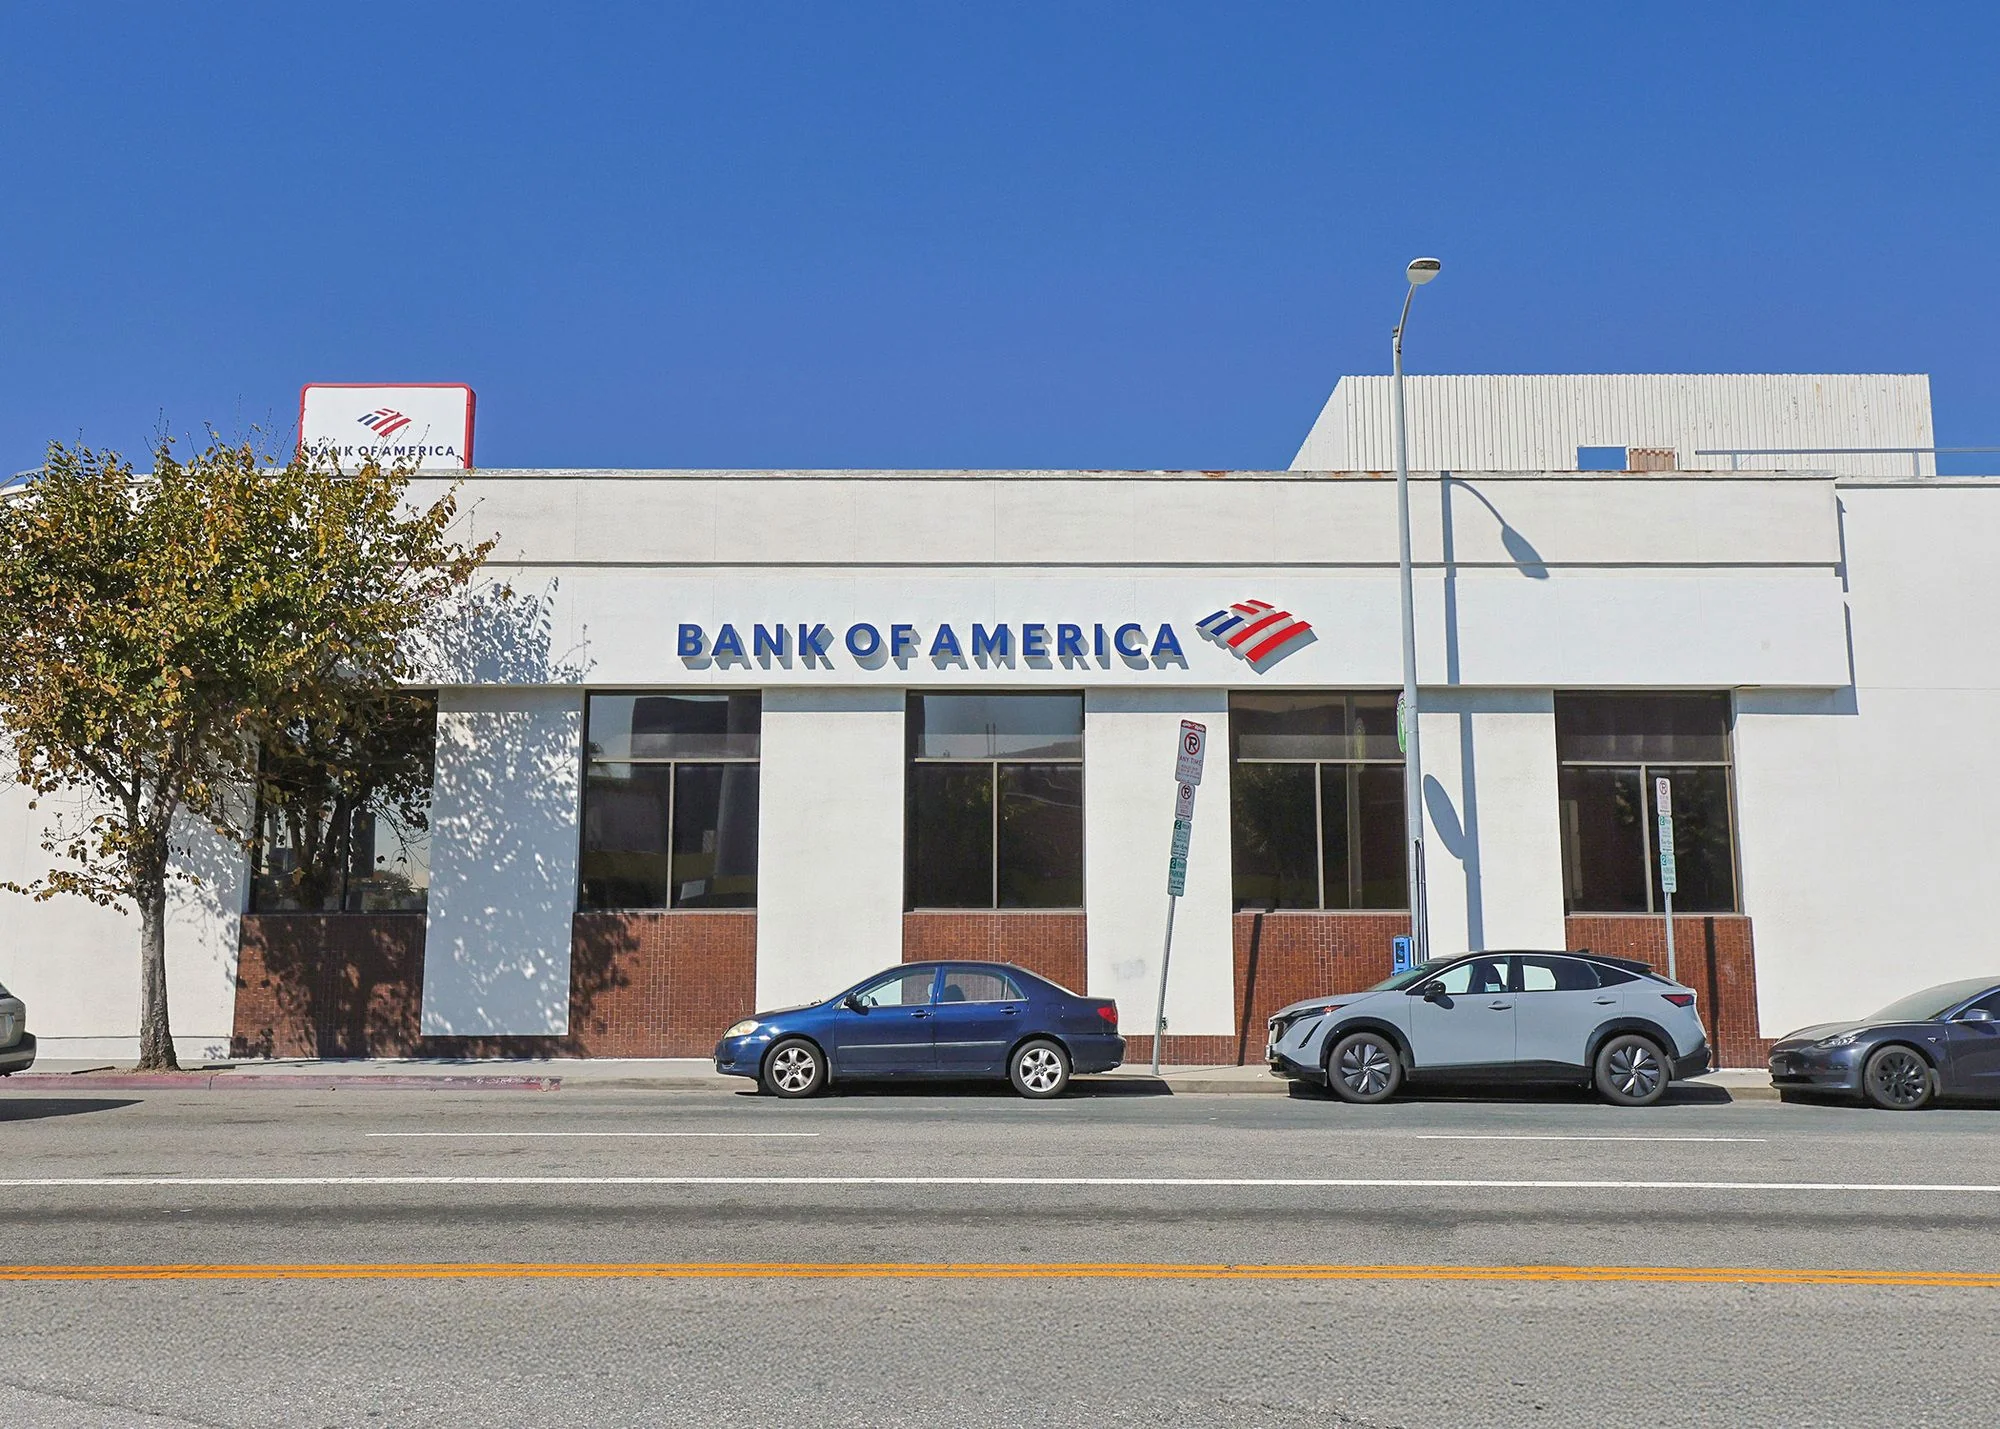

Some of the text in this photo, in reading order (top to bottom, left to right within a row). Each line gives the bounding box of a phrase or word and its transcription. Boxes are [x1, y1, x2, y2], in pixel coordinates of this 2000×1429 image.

[310, 446, 455, 457] BANK OF AMERICA
[677, 623, 1183, 657] BANK OF AMERICA
[1178, 755, 1190, 764] ANY
